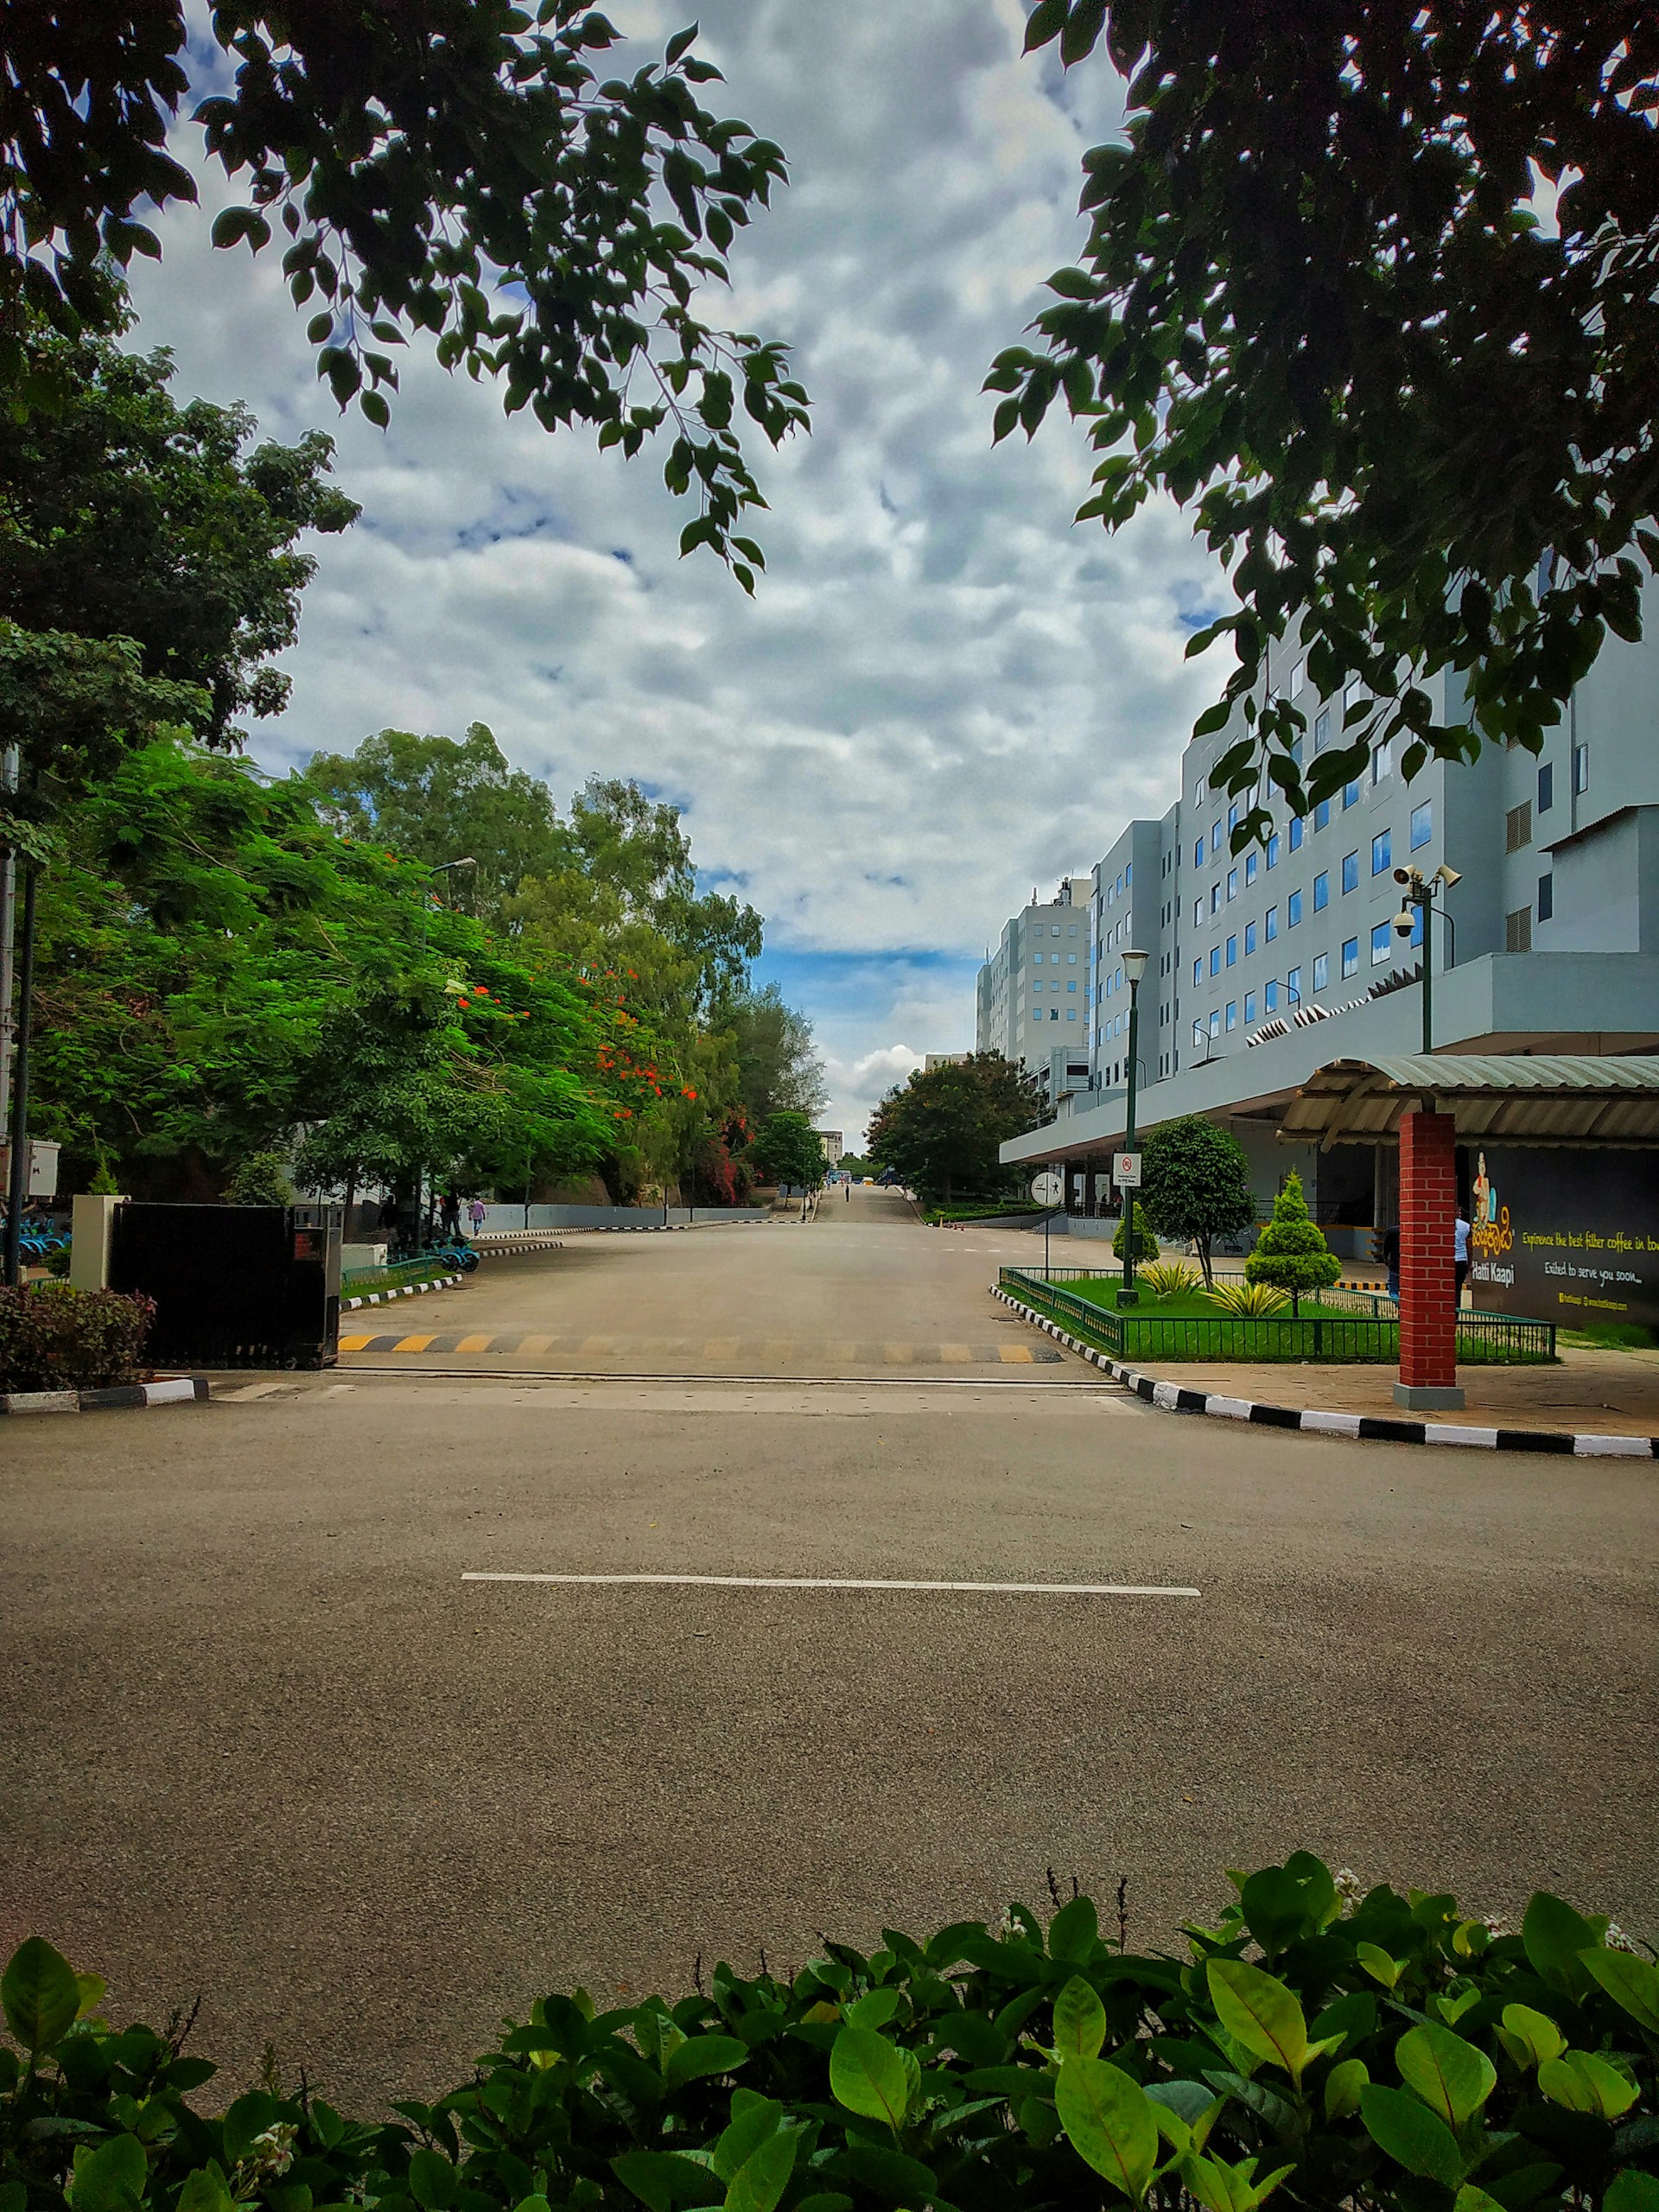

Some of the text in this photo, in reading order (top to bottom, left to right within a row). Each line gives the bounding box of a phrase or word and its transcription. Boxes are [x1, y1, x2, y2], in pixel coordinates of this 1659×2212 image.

[1555, 1232, 1567, 1247] the
[1568, 1230, 1584, 1248] best
[1607, 1231, 1634, 1254] coffee
[1635, 1236, 1645, 1250] in
[1471, 1261, 1515, 1289] Hatti Kaapi
[1568, 1262, 1577, 1277] to
[1578, 1267, 1598, 1280] serve
[1599, 1269, 1615, 1287] you
